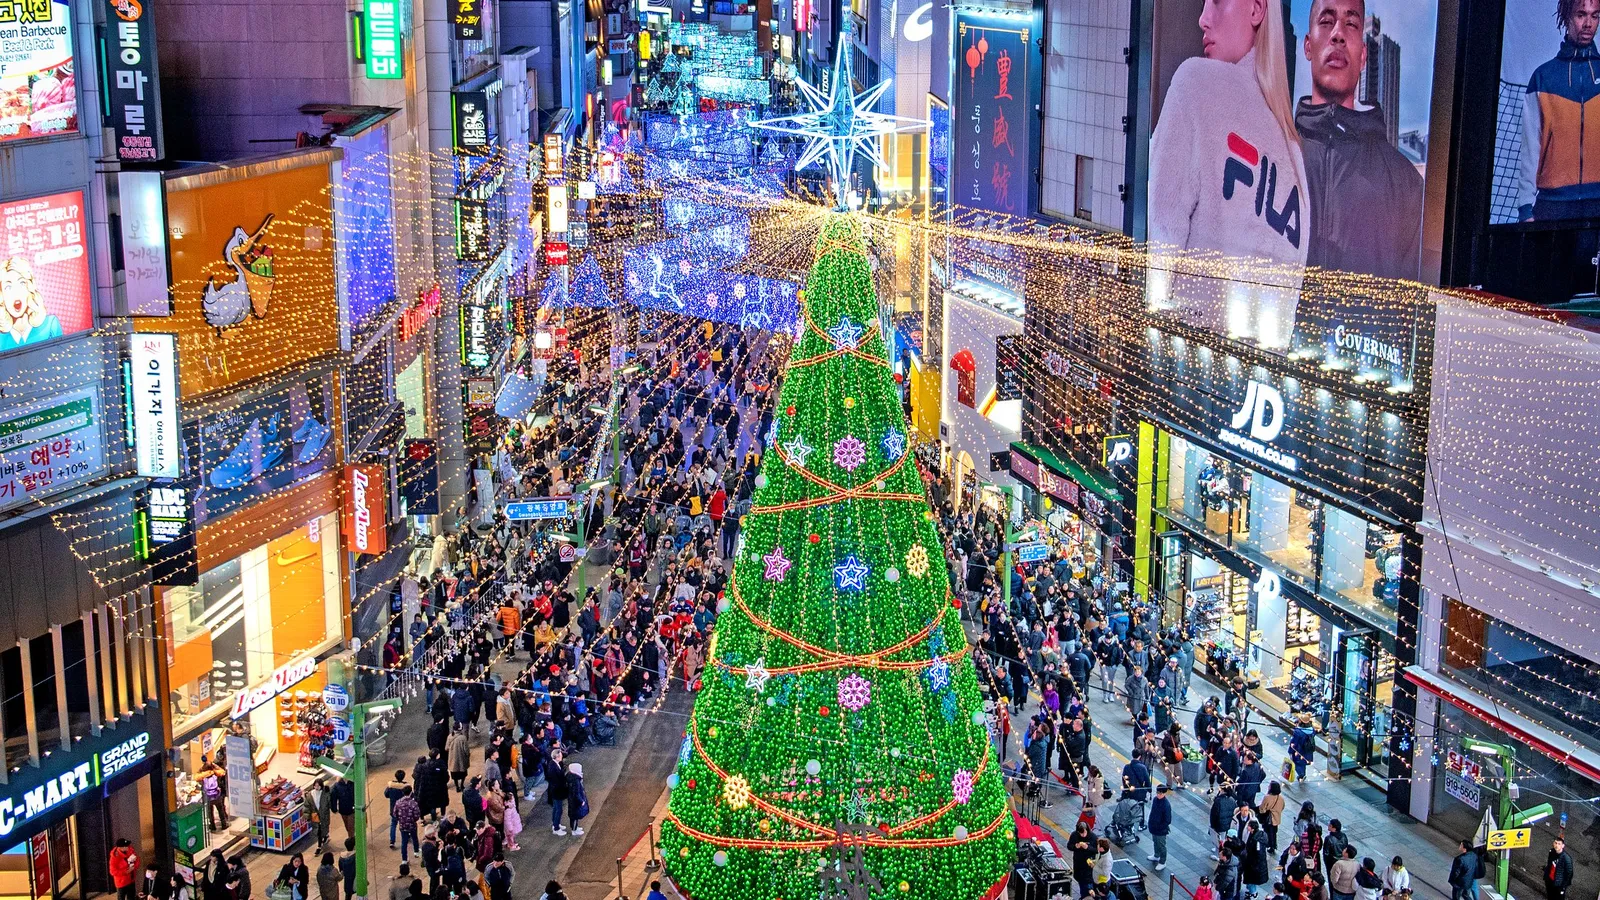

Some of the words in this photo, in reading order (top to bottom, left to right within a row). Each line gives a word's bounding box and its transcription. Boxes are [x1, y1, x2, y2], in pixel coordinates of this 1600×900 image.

[20, 25, 67, 38] Barbecue
[462, 28, 475, 36] 5F
[462, 103, 476, 114] 4F
[1222, 131, 1301, 250] FILA
[147, 359, 163, 416] 이가자
[1231, 380, 1284, 441] JD
[1107, 442, 1131, 462] JD
[150, 488, 186, 505] ABC
[151, 505, 186, 517] MART
[102, 732, 149, 765] GRAND
[103, 746, 146, 777] STAGE
[1446, 777, 1479, 803] 919-5500
